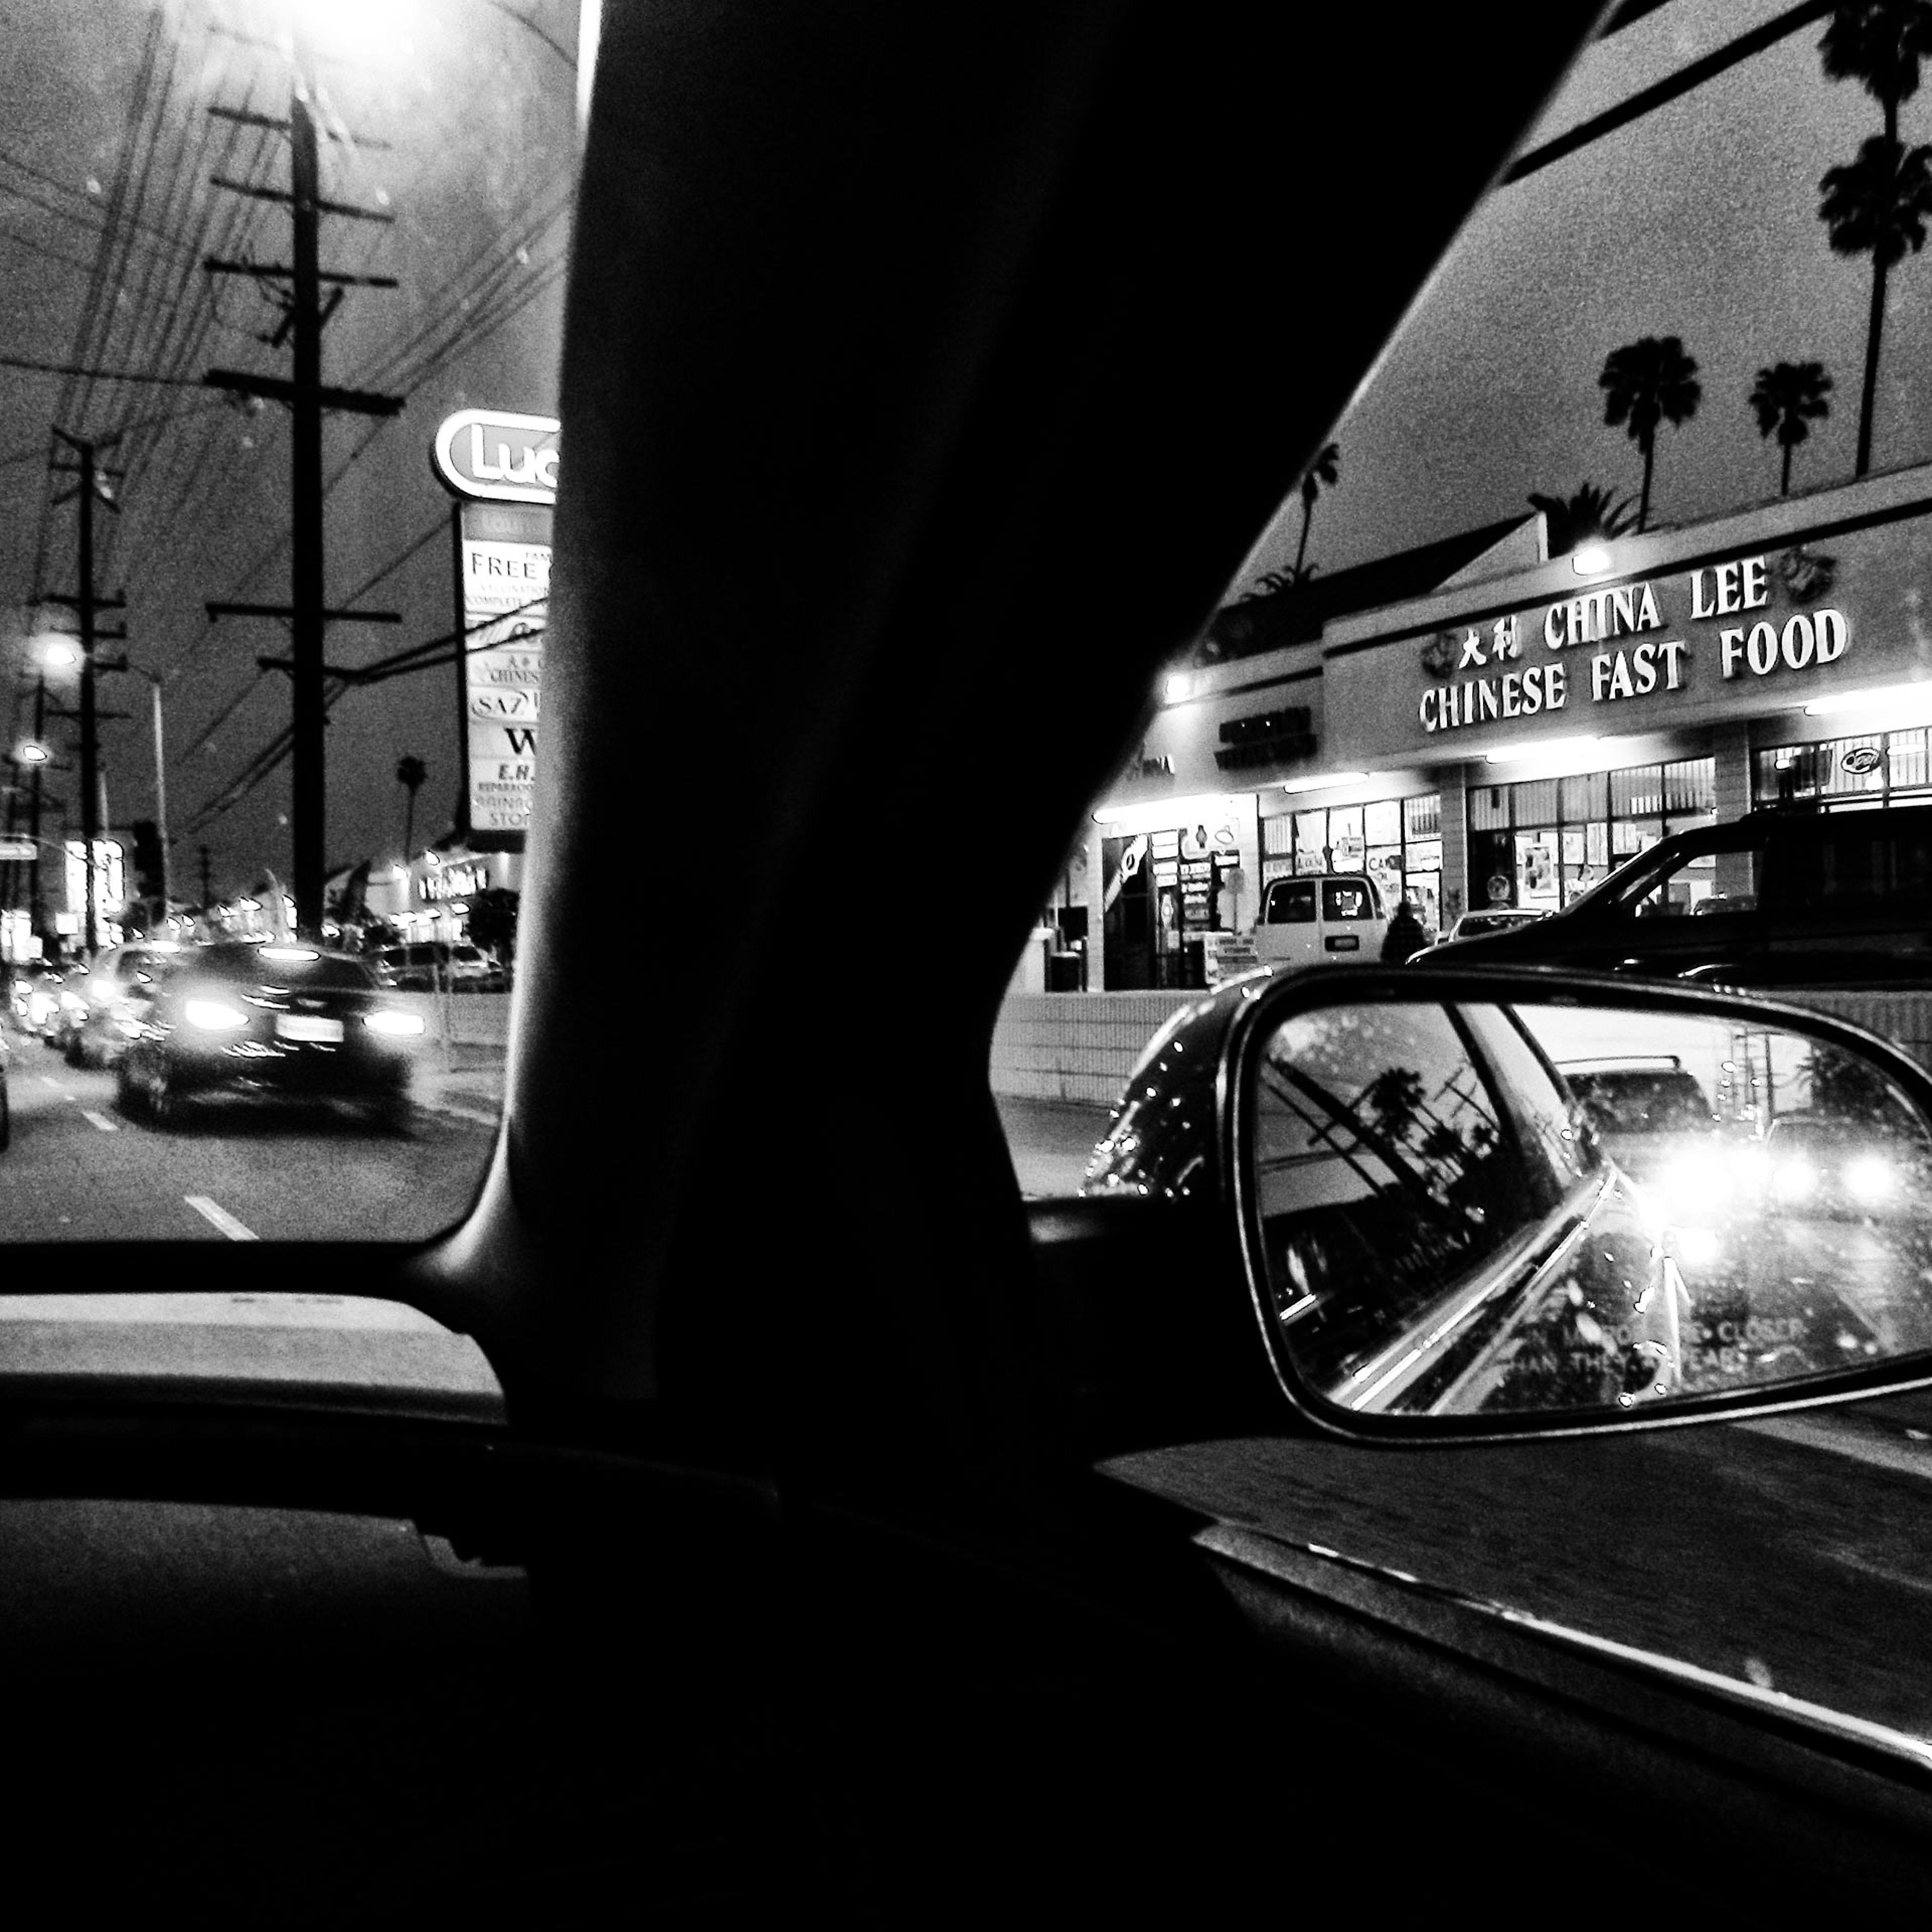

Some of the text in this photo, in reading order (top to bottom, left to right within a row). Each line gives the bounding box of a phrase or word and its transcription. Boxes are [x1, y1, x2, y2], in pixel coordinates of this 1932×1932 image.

[471, 552, 537, 579] FREE
[1544, 555, 1769, 650] CHINA LEE
[1418, 608, 1848, 733] CHINESE FAST FOOD
[1458, 614, 1519, 669] 大利
